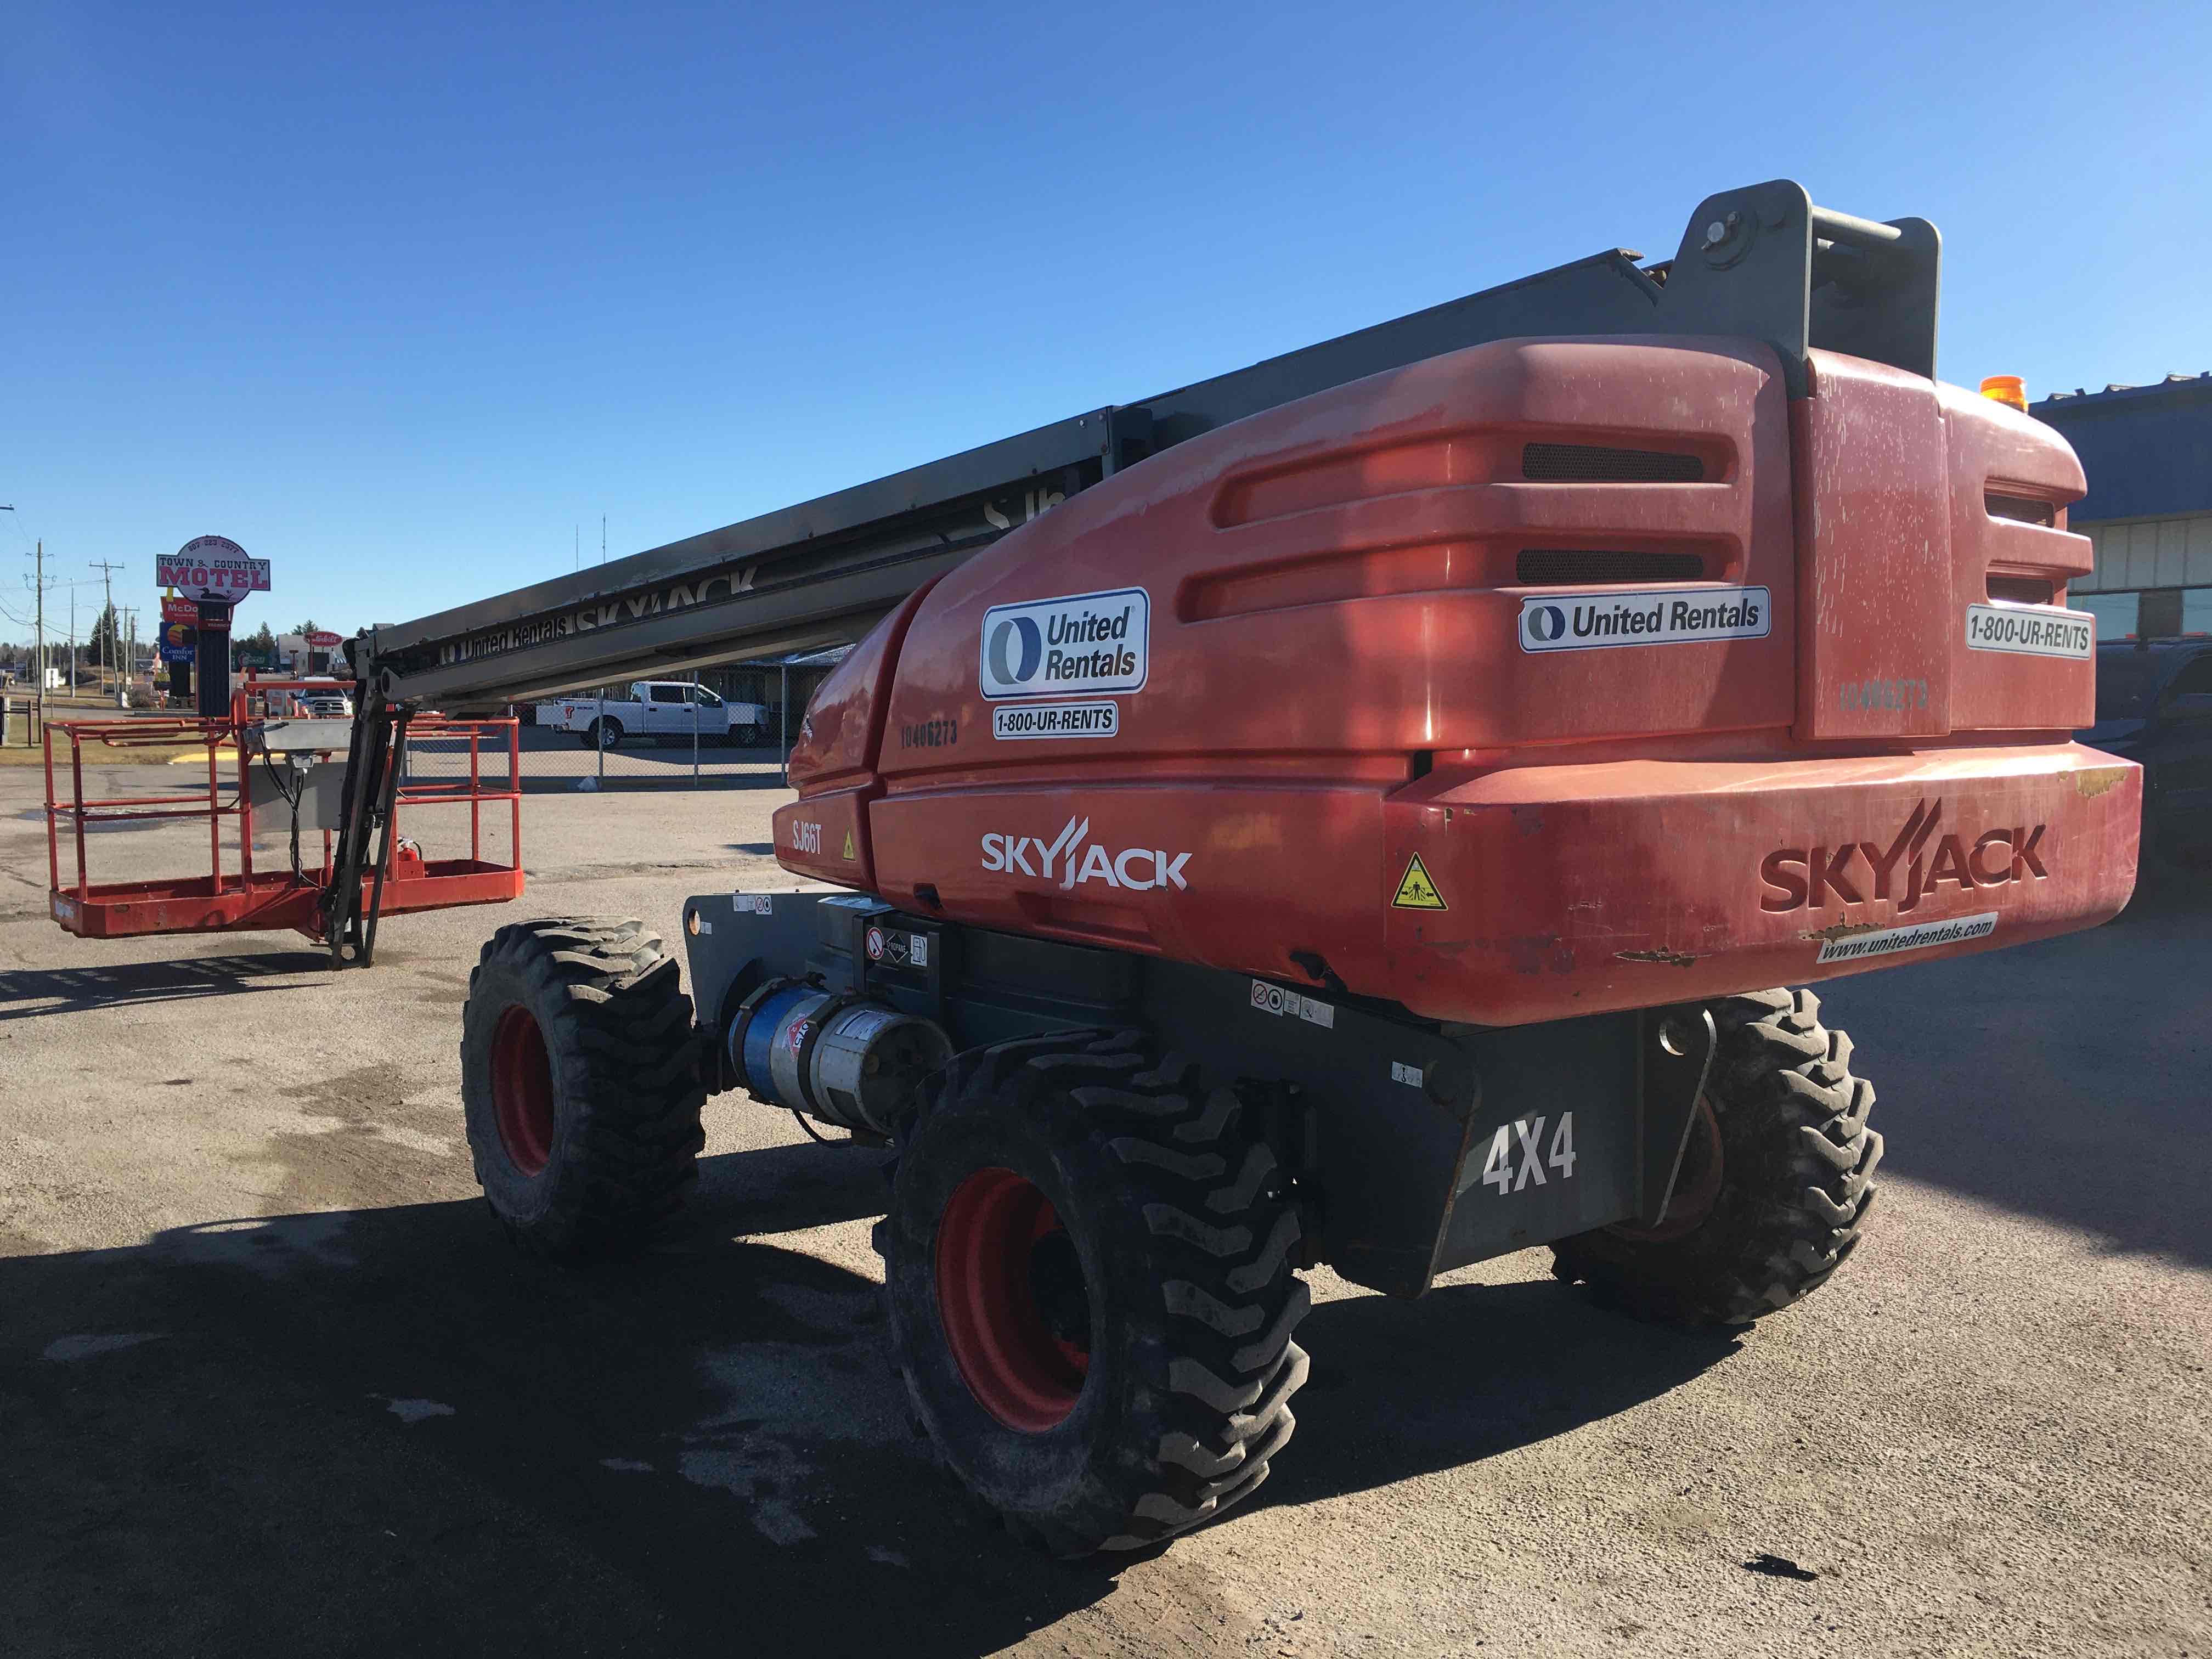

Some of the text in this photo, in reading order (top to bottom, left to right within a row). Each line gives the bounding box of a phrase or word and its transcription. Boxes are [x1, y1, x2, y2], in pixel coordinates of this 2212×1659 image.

[159, 566, 268, 589] MOTEL
[160, 557, 267, 570] TOWN & COUNTRY
[167, 603, 198, 612] McDo
[1047, 605, 1130, 646] United
[1572, 598, 1759, 637] United Rentals
[162, 646, 194, 654] Comfor
[1970, 614, 2089, 651] 1-800-UR-RENTS
[1045, 644, 1136, 681] Rentals
[997, 708, 1113, 732] 1-800-UR-RENTS
[793, 819, 821, 855] SJ66T
[981, 815, 1193, 891] SKYJACK
[1759, 797, 2049, 915] SKYJACK
[1822, 918, 1993, 960] www.unitedrentals.com
[1482, 1111, 1577, 1195] 4X4
